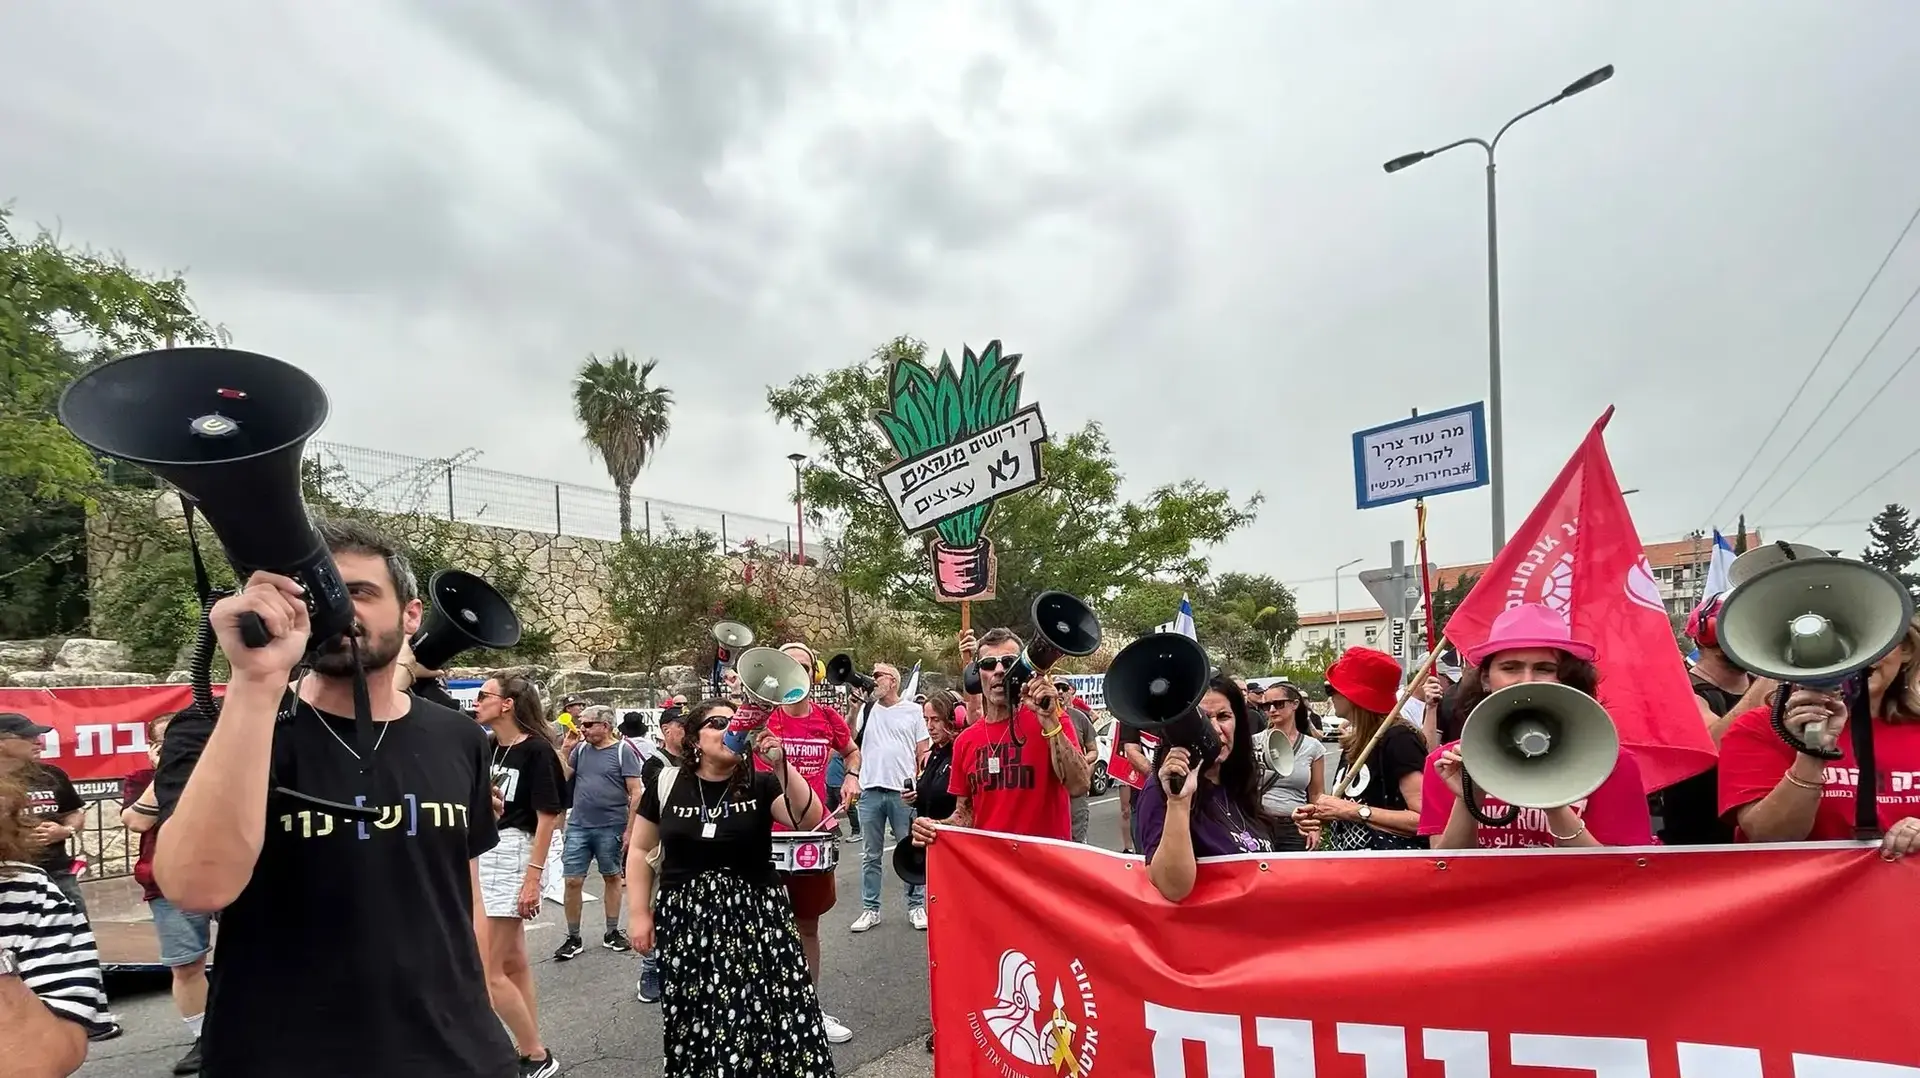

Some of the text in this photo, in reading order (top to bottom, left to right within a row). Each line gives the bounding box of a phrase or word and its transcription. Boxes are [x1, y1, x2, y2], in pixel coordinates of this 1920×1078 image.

[900, 417, 1030, 492] דרושים מנהיגים
[1371, 425, 1465, 457] מה עוד צריך
[1383, 445, 1454, 471] לקרות??
[914, 449, 1020, 515] לא עציצים
[1370, 461, 1472, 492] #בחירות_עכשיו
[1069, 957, 1098, 1019] בונות
